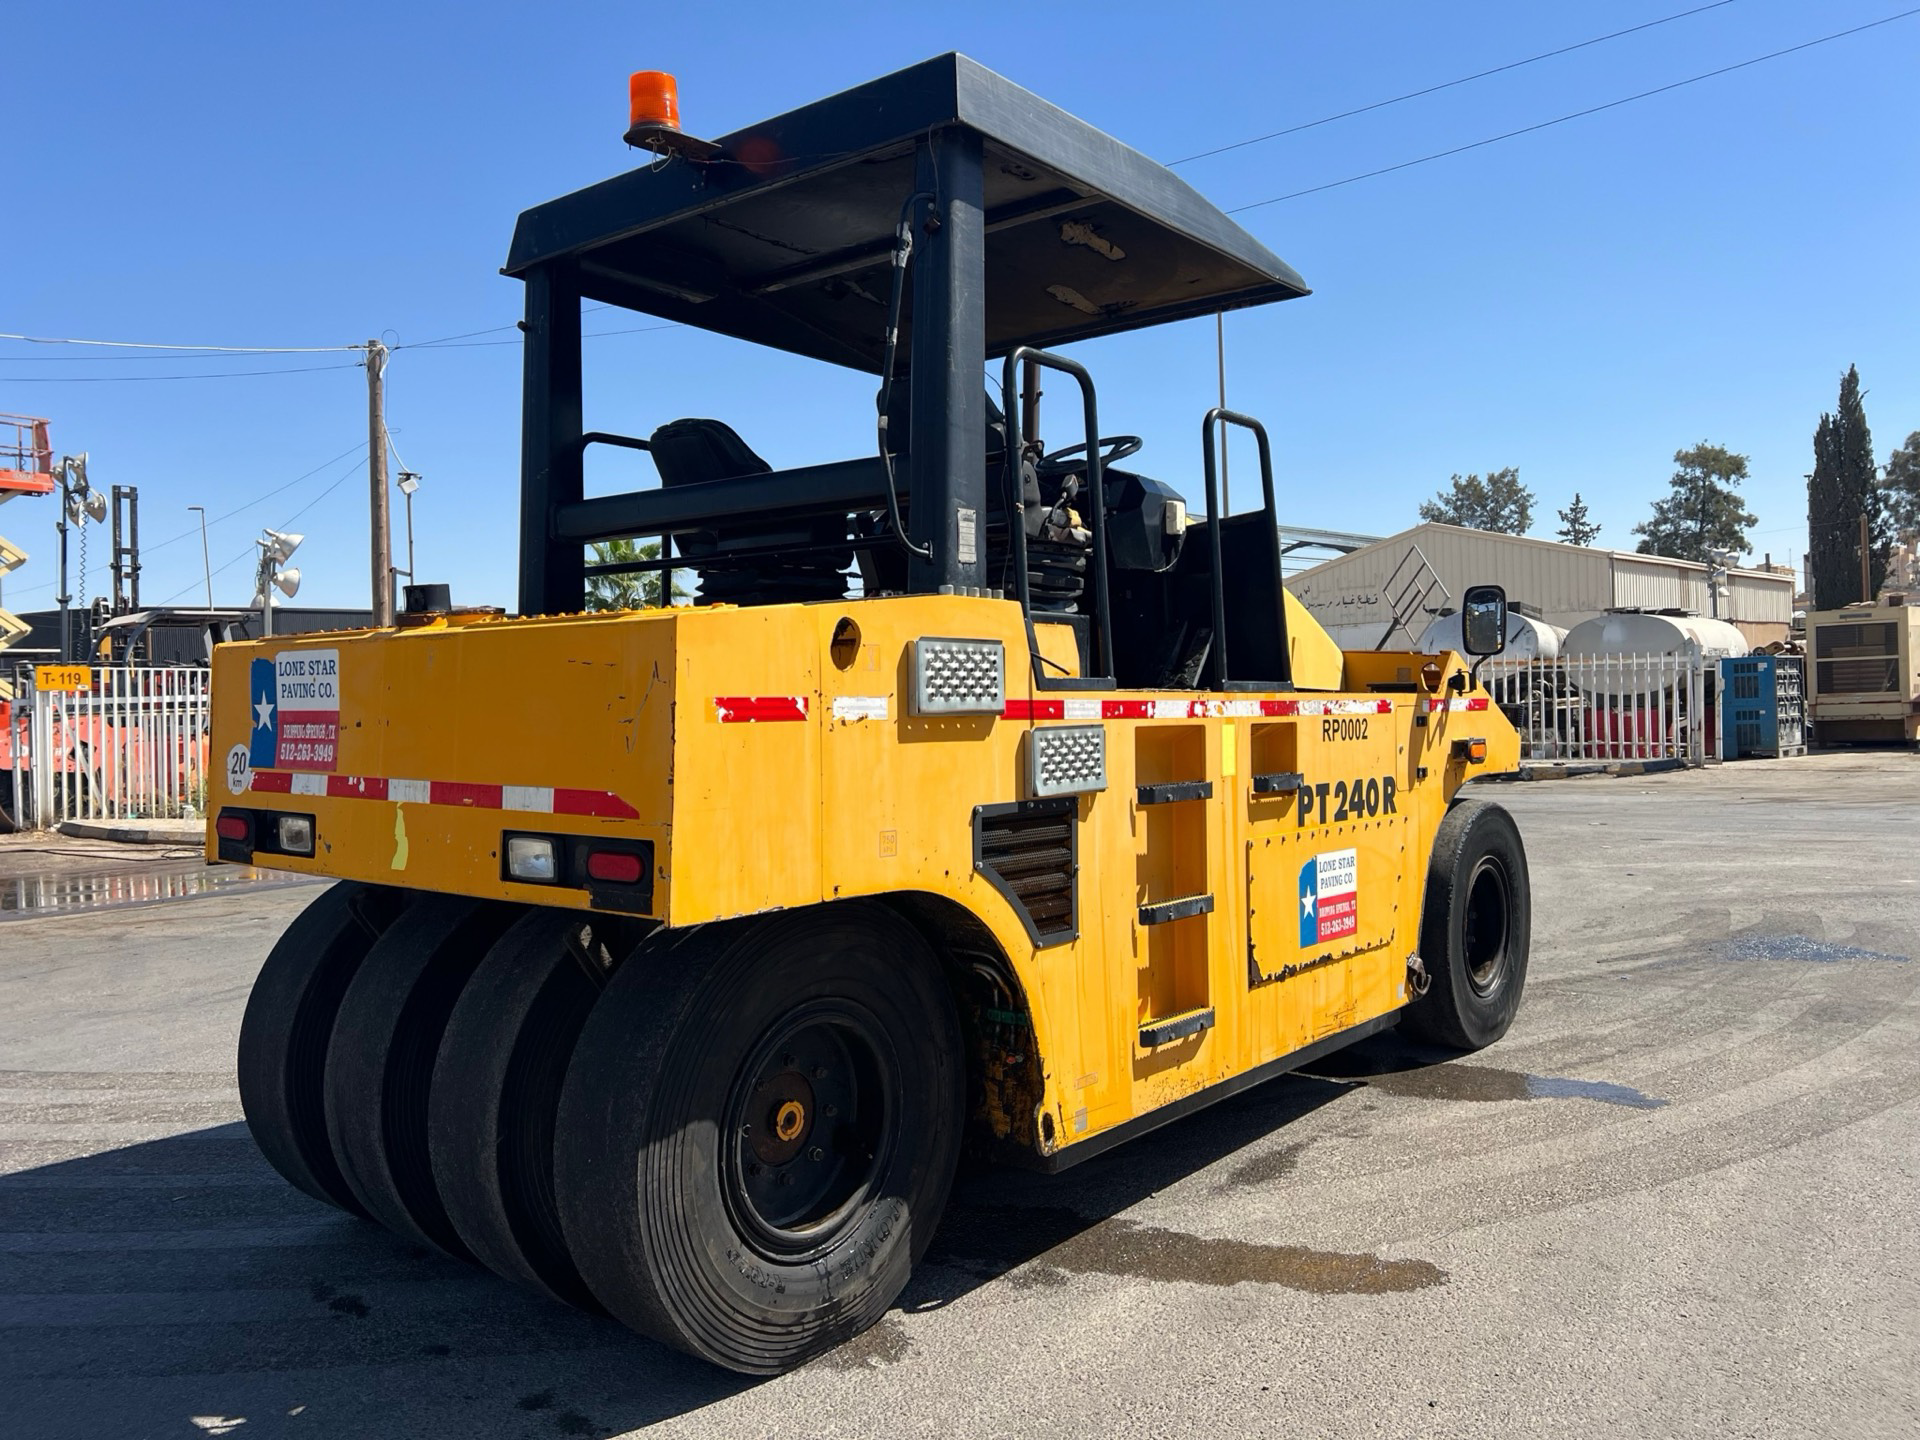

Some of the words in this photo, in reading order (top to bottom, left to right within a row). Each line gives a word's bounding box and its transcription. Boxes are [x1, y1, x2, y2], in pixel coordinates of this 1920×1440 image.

[1335, 593, 1355, 609] غيار
[1356, 593, 1379, 610] قطع
[279, 661, 305, 677] LONE
[308, 660, 336, 676] STAR
[281, 683, 315, 699] PAVING
[318, 682, 335, 698] CO.
[1322, 718, 1368, 742] RP0002
[280, 743, 334, 762] 512-263-3949
[231, 752, 247, 774] 20
[232, 779, 242, 788] km
[1319, 859, 1337, 873] LONE
[1338, 856, 1355, 869] STAR
[1321, 875, 1343, 889] PAVING
[1344, 872, 1354, 884] CO.
